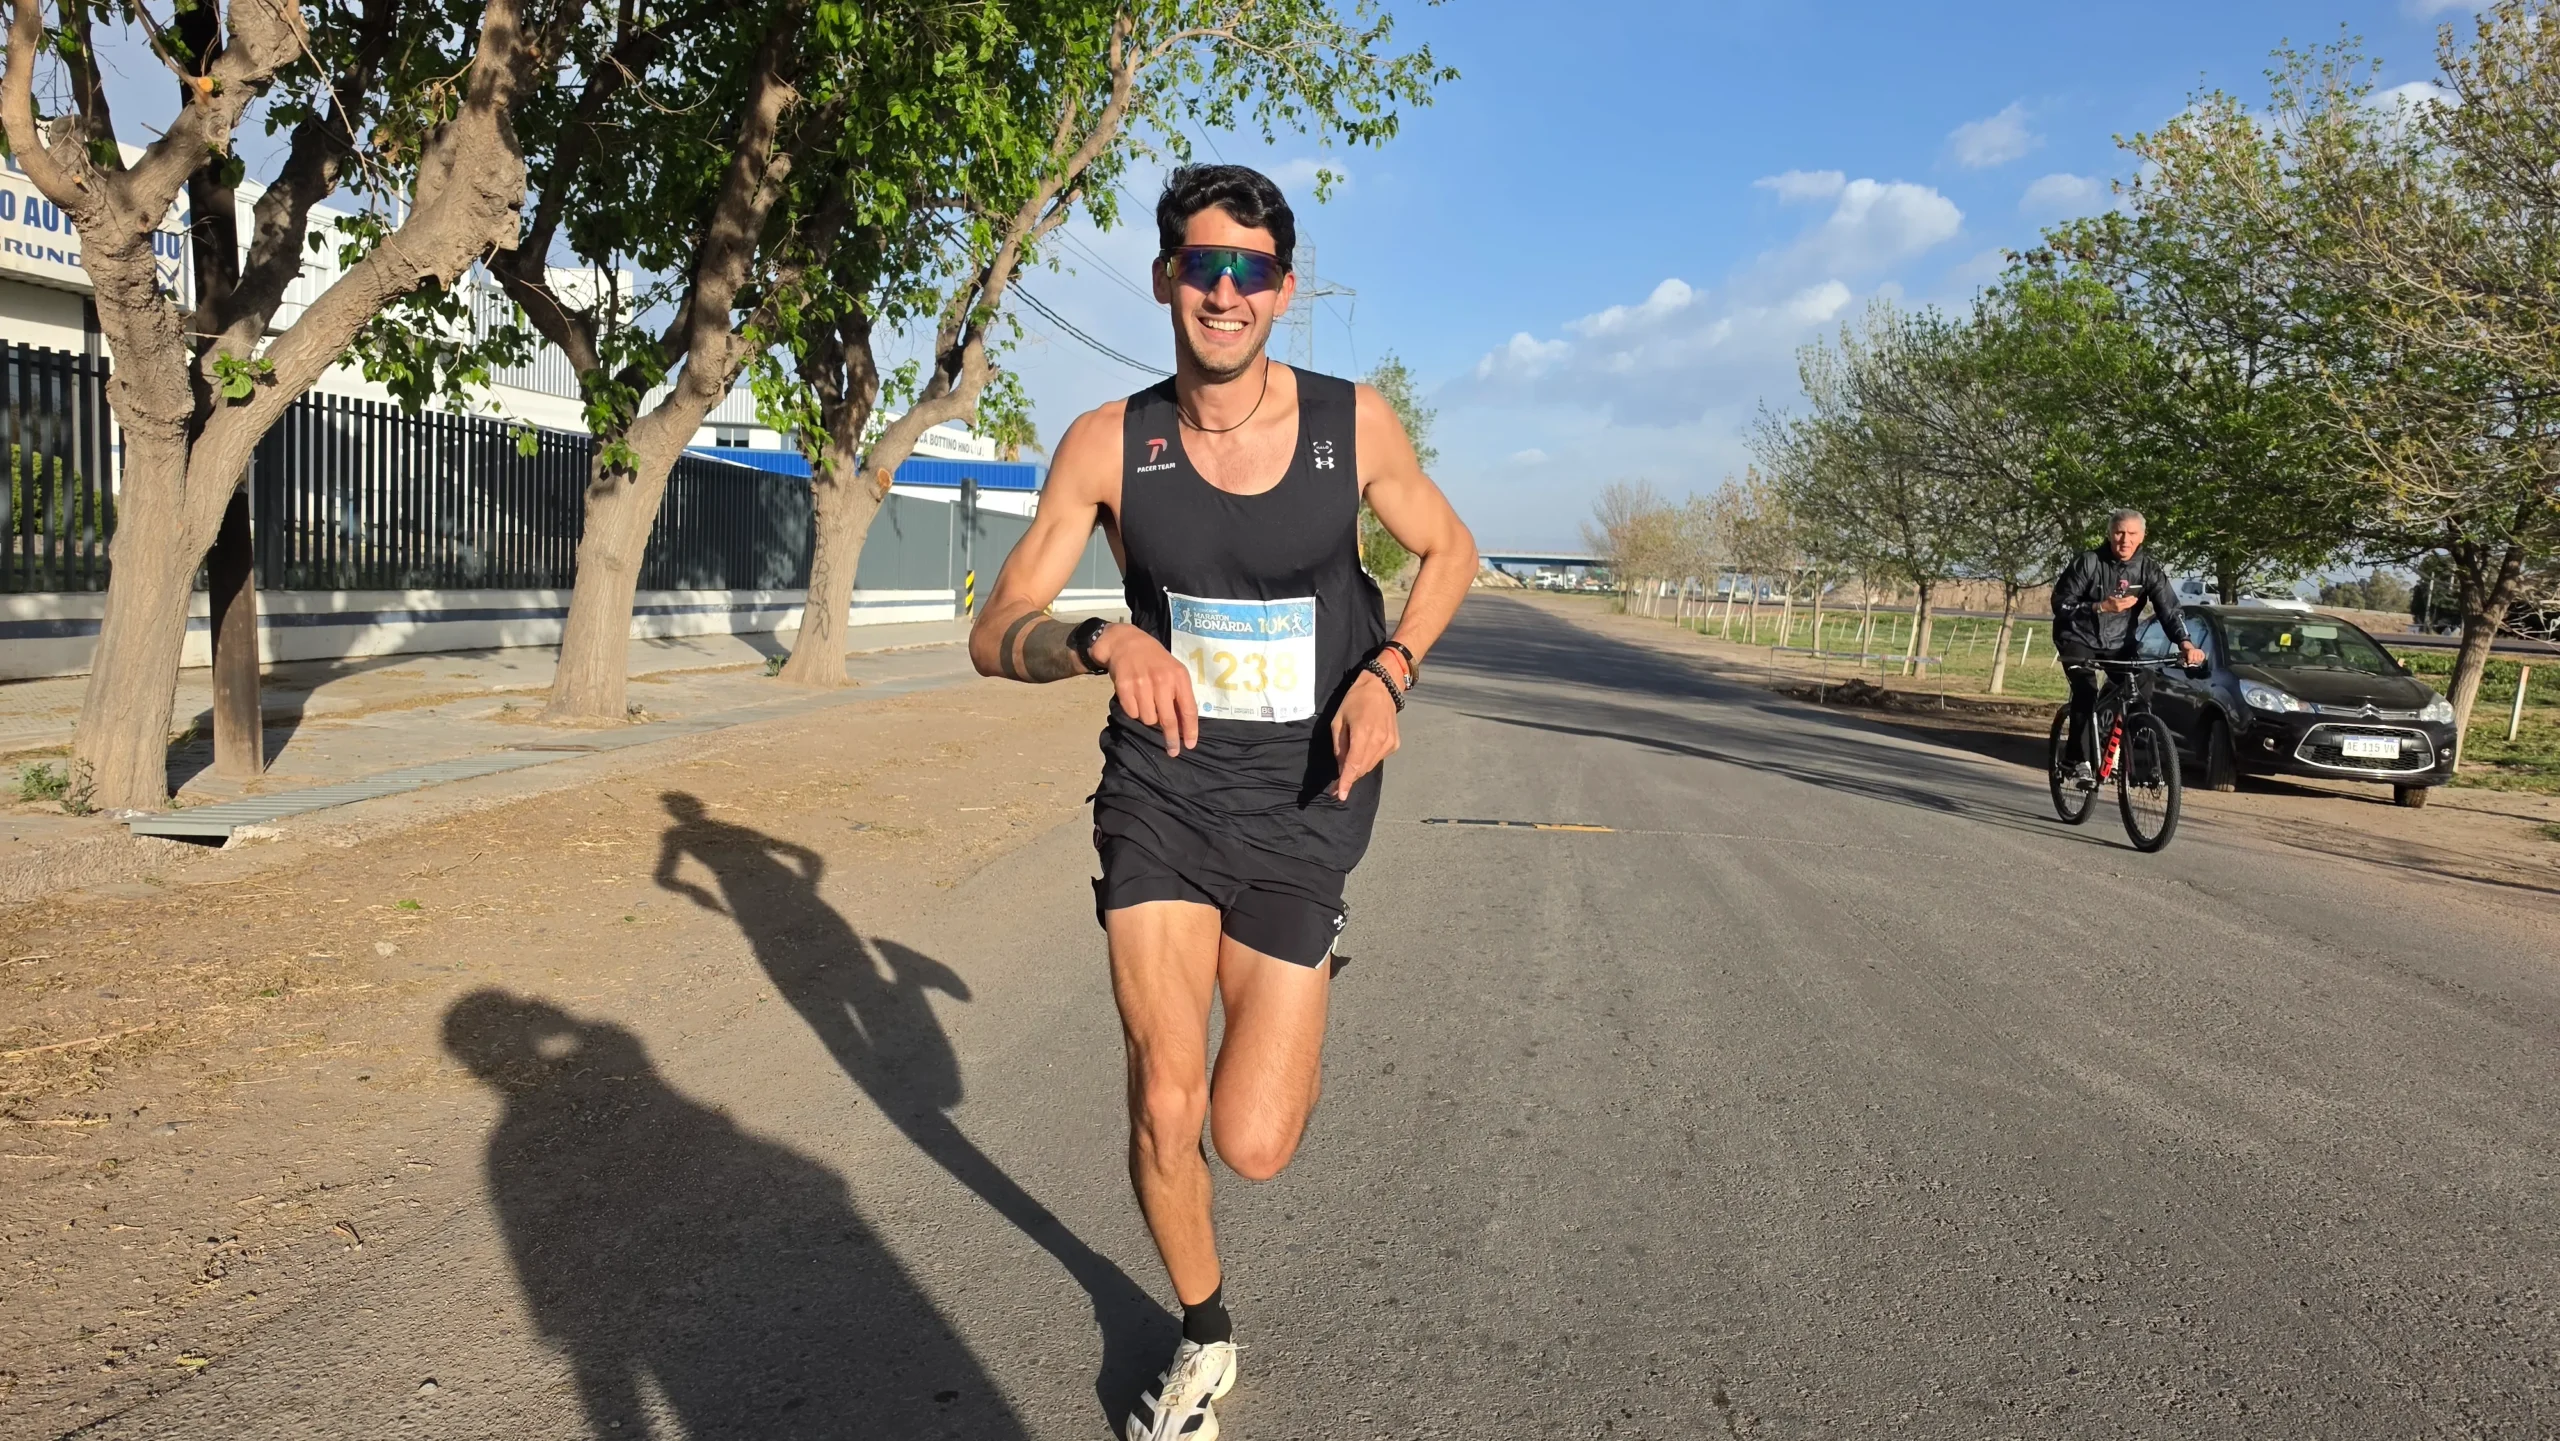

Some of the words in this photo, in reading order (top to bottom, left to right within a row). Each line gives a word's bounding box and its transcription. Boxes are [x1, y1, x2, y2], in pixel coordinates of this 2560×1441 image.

[0, 236, 82, 268] RUND
[1137, 465, 1157, 473] PACER
[1158, 462, 1176, 470] TEAM
[1194, 617, 1254, 633] BONARDA
[1257, 615, 1291, 635] 10K
[1188, 647, 1298, 693] 1238
